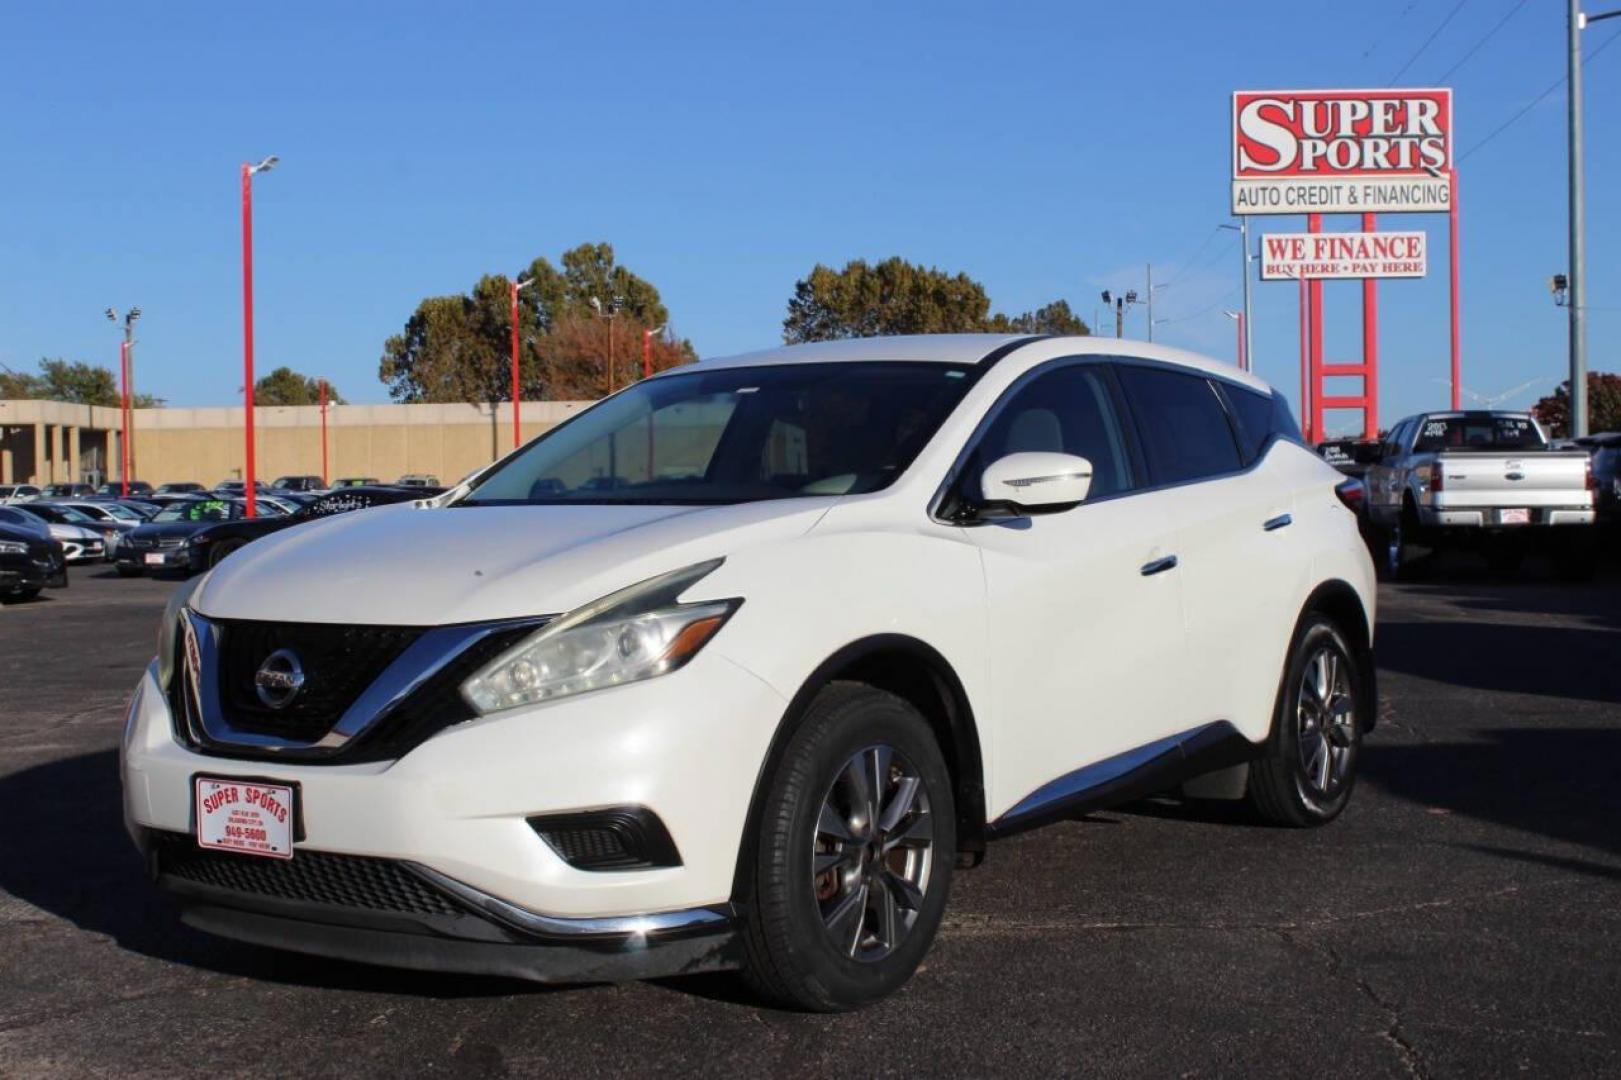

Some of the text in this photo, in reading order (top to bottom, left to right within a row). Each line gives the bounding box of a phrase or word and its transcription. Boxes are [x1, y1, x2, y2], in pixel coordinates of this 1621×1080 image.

[1237, 184, 1449, 206] AUTO CREDIT & FINANCING
[1267, 236, 1422, 260] WE FINANCE
[1266, 262, 1423, 275] BUY HERE PAY HERE
[203, 787, 287, 823] SUPER SPORTS
